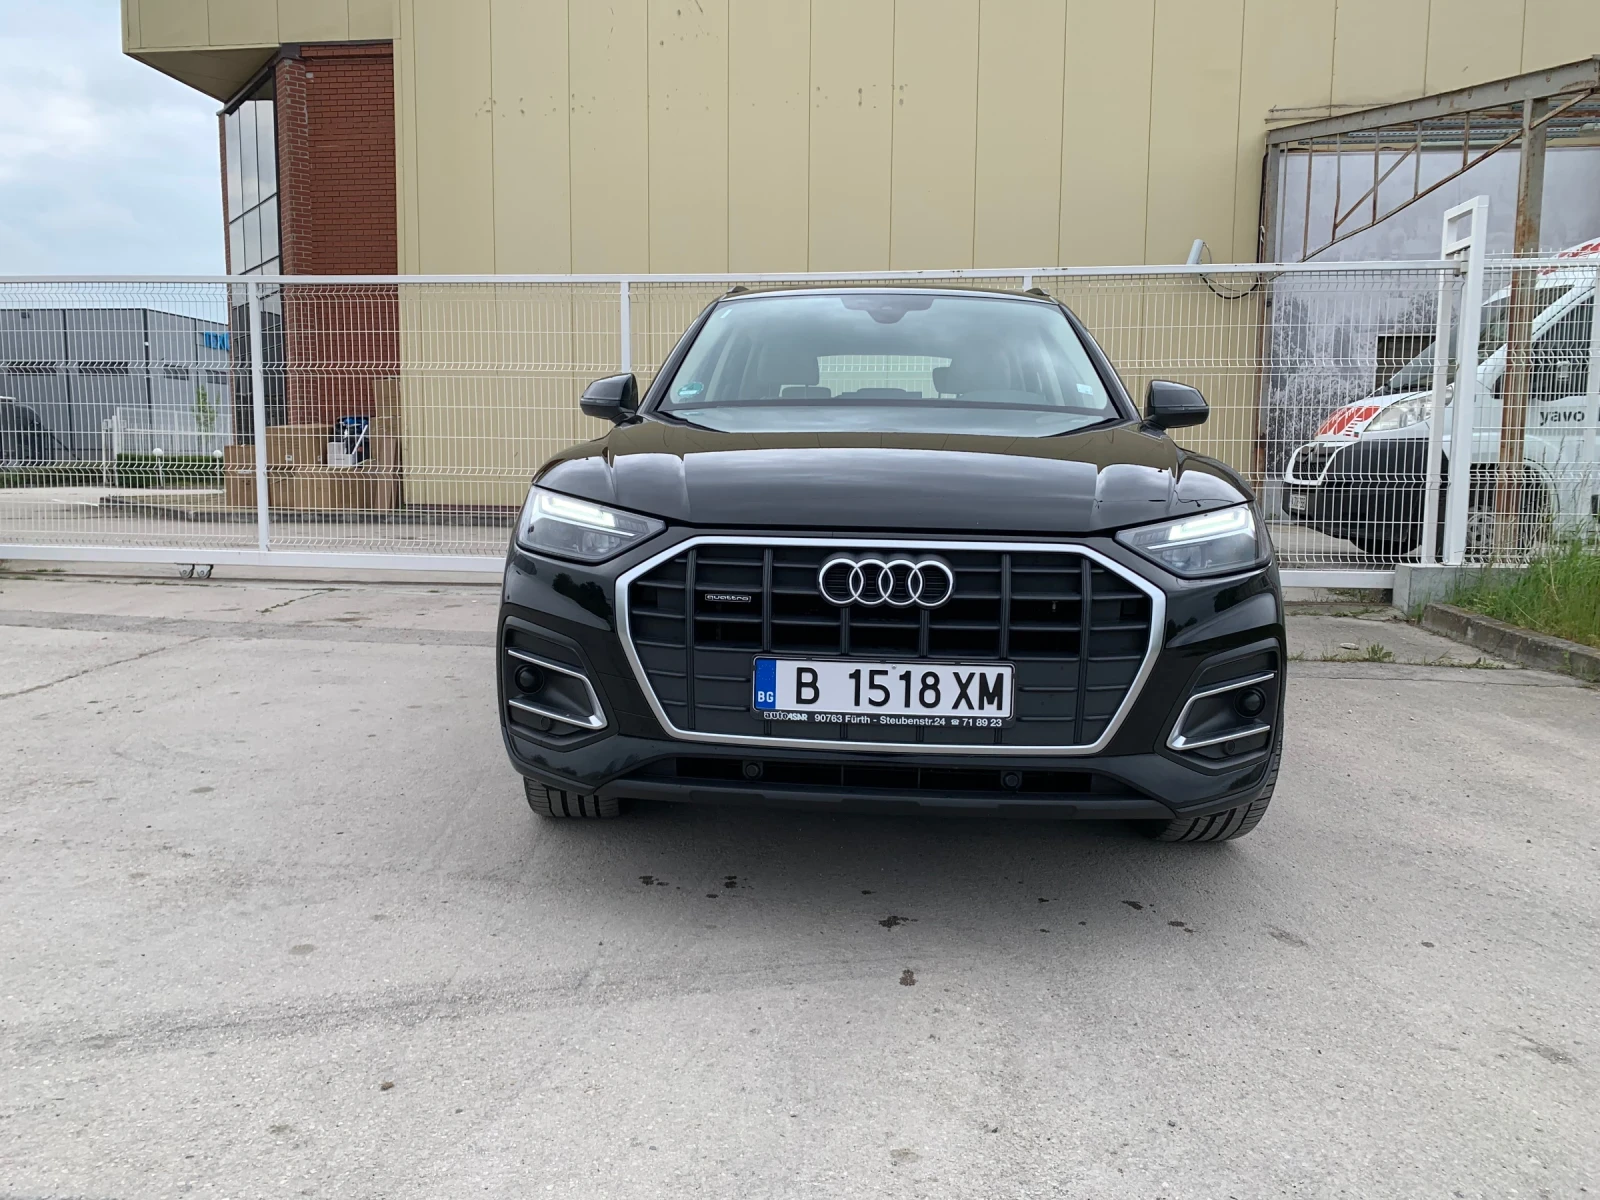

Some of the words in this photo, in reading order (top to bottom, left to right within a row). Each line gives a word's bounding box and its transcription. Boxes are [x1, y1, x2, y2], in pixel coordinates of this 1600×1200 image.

[1539, 411, 1585, 427] yavo
[706, 594, 750, 602] quattro
[796, 666, 820, 705] B
[848, 668, 941, 709] 1518
[951, 671, 1004, 711] XM
[757, 691, 774, 703] BG
[814, 713, 843, 723] 90763
[845, 714, 871, 724] Fürth
[962, 718, 973, 727] 71
[975, 718, 988, 727] 89
[990, 718, 1002, 727] 23
